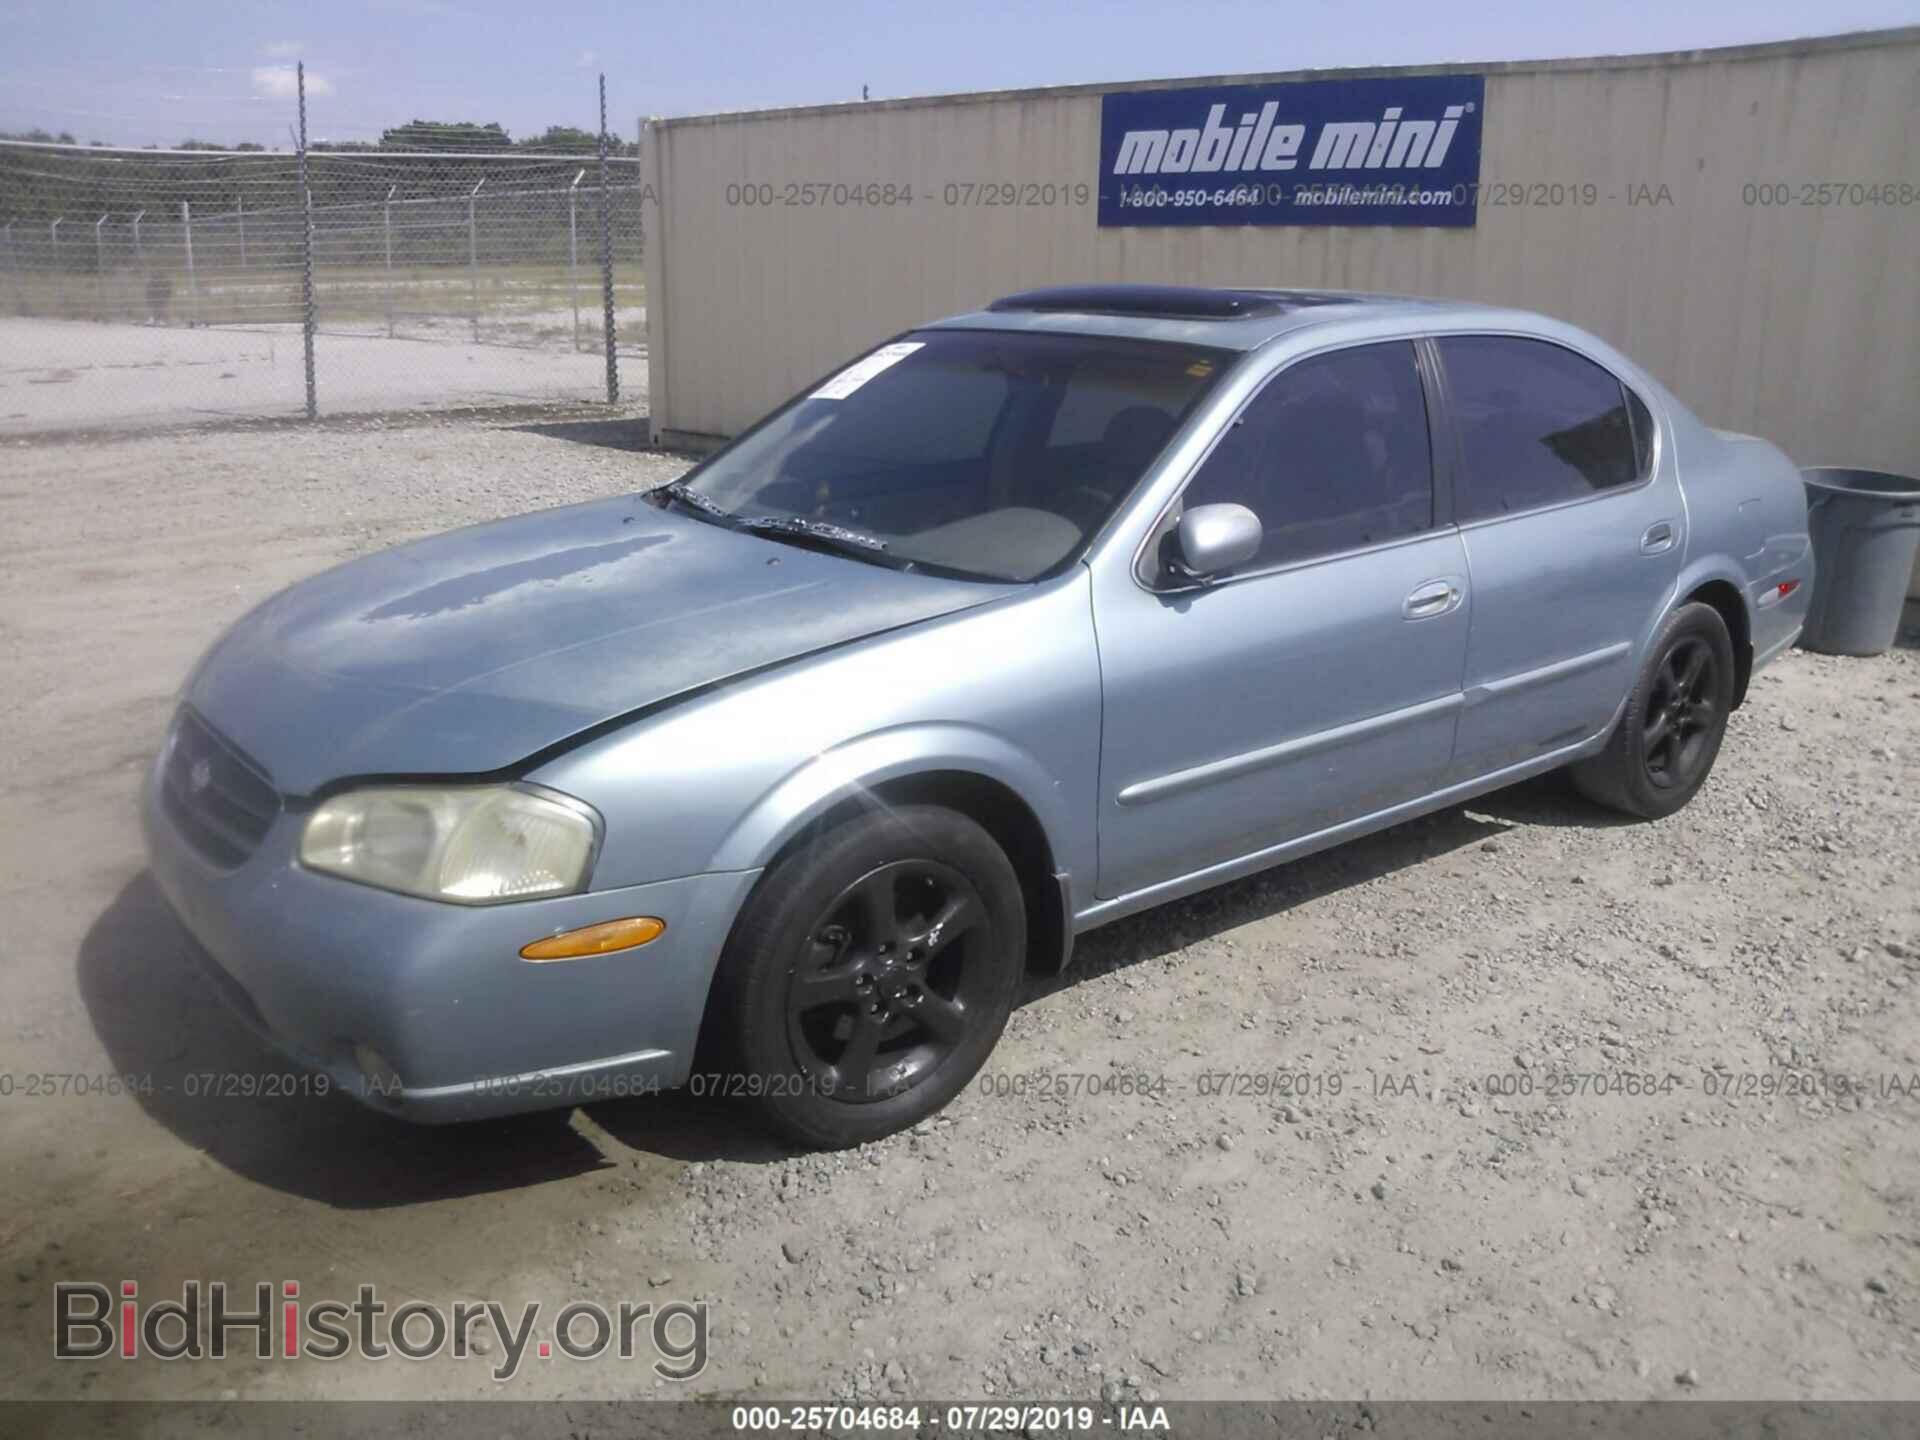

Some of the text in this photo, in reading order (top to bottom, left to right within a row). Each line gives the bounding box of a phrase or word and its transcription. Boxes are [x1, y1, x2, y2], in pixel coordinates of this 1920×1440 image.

[1113, 100, 1466, 175] mobile mini
[1294, 186, 1452, 206] mobilemini.com
